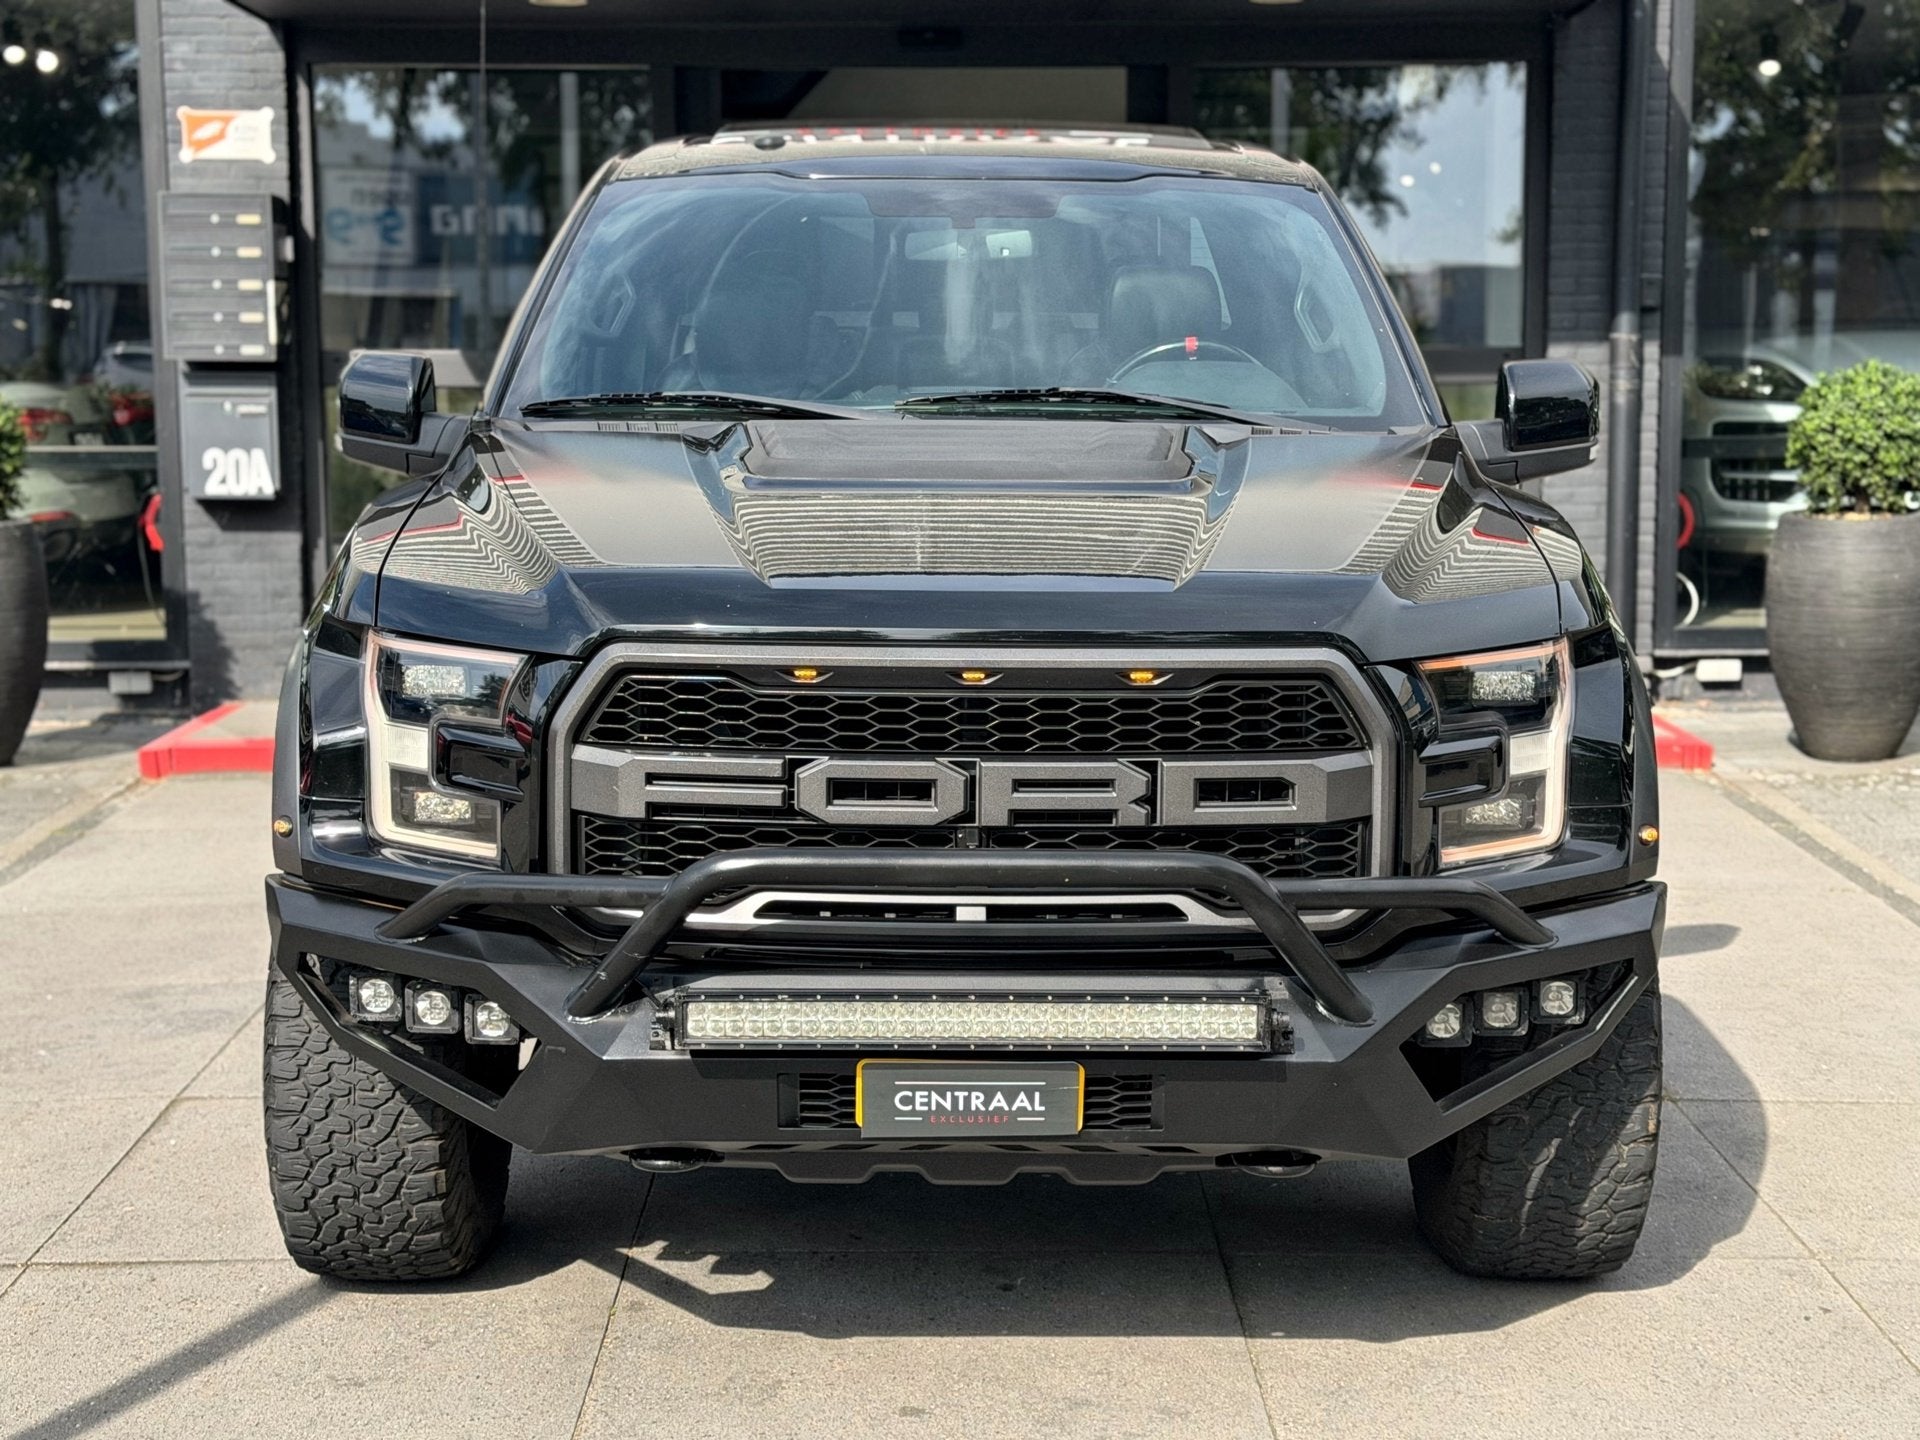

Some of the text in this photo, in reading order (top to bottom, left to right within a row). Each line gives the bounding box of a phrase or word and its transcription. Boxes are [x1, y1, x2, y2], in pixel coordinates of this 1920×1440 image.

[202, 446, 275, 496] 20A
[571, 745, 1373, 827] FORD
[894, 1090, 1046, 1112] CENTRAAL
[929, 1115, 1010, 1124] EXCLUSIEF
